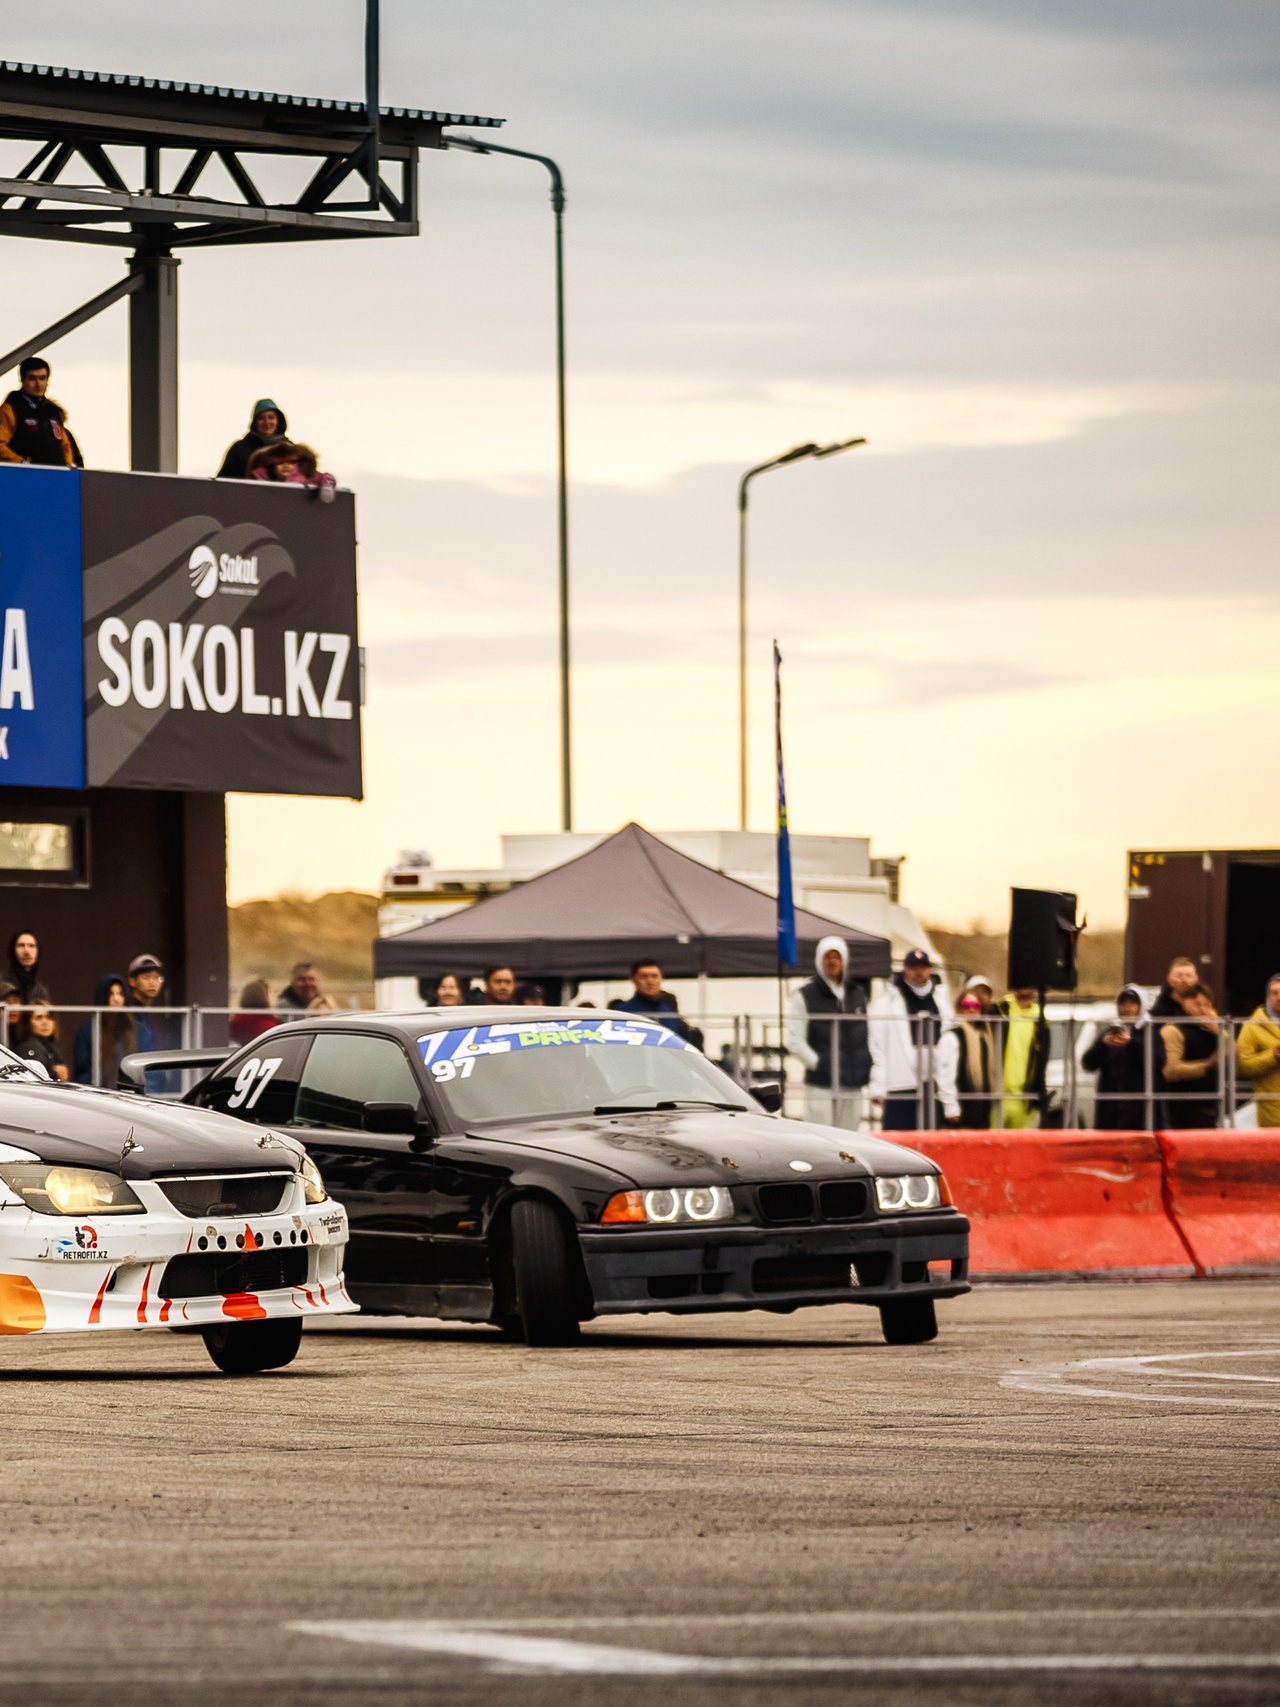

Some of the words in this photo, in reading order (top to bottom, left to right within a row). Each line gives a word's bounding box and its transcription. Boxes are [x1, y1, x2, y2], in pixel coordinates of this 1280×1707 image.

[97, 616, 353, 720] SOKOL.KZ
[518, 1028, 606, 1046] DRIFT
[227, 1057, 283, 1109] 97
[431, 1056, 476, 1083] 97
[63, 1250, 108, 1260] RETROFIT.KZ
